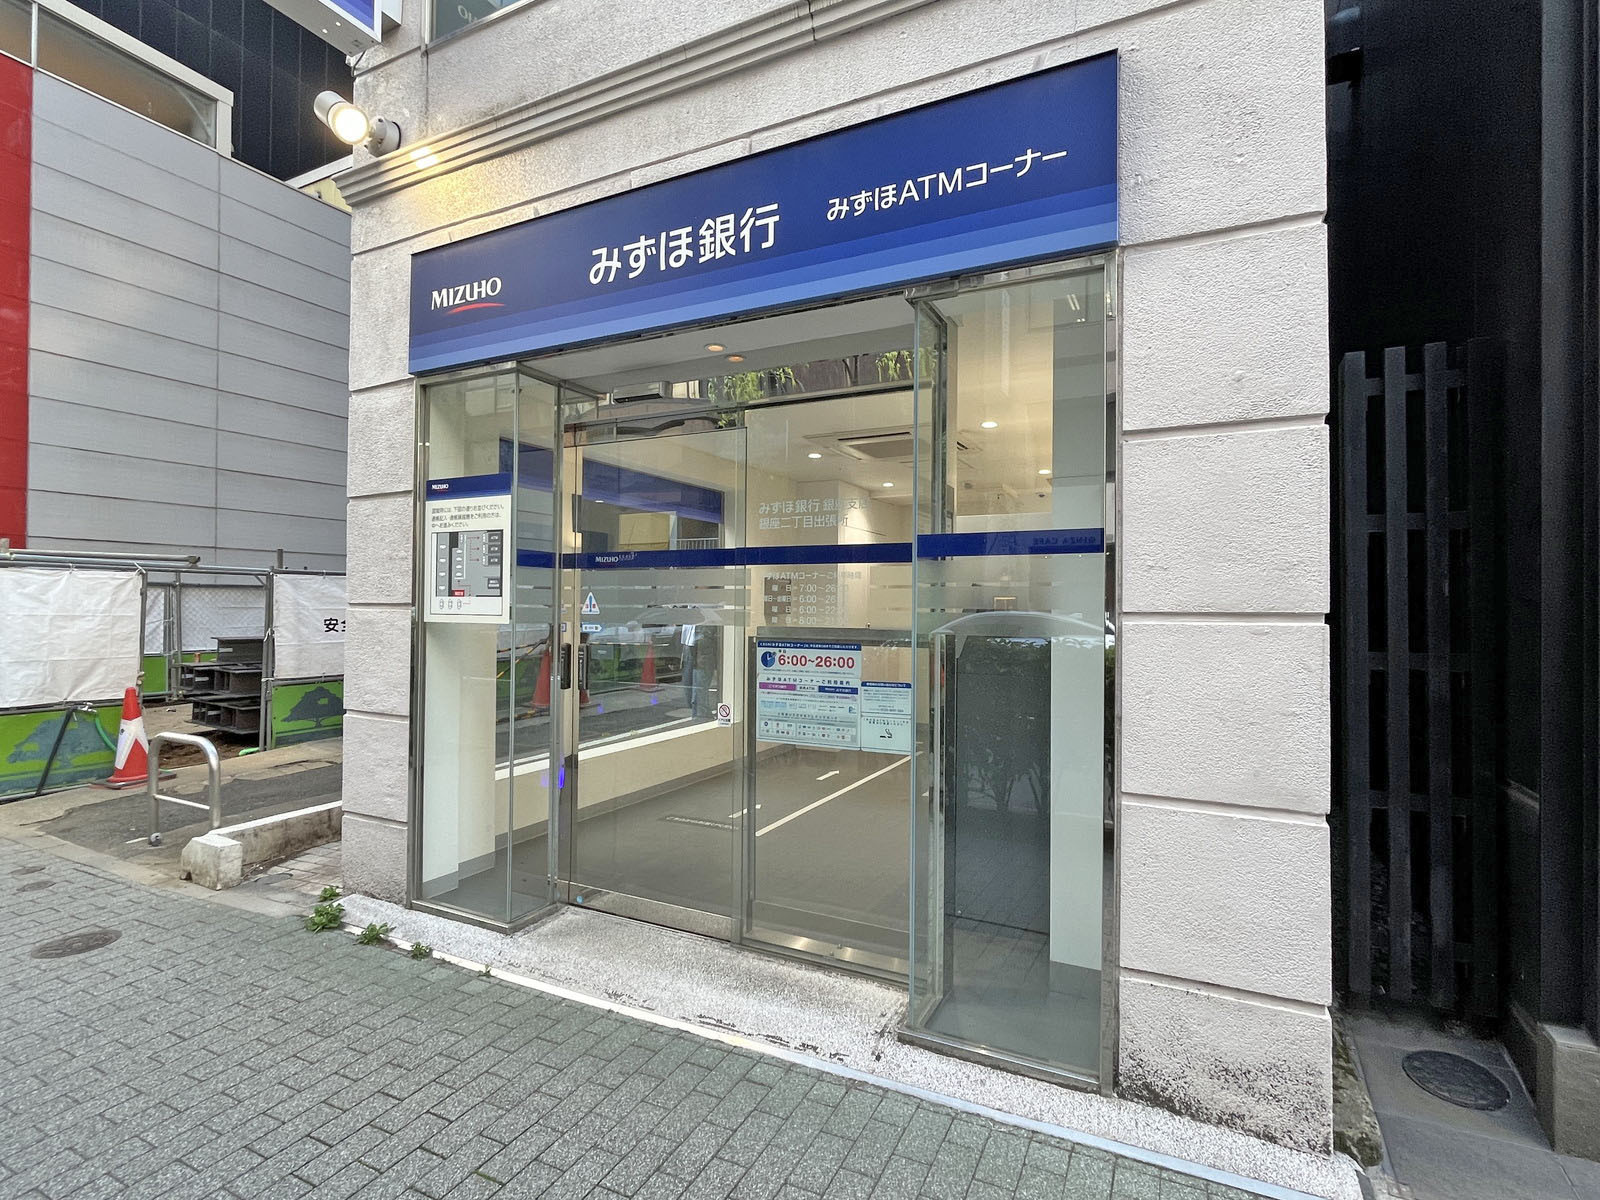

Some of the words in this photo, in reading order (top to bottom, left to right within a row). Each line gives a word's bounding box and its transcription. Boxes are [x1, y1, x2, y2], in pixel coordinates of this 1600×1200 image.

[826, 148, 1068, 222] みずほATMコーナー
[588, 202, 780, 286] みずほ銀行
[431, 276, 502, 311] MIZUHO
[758, 498, 821, 514] みずほ銀行
